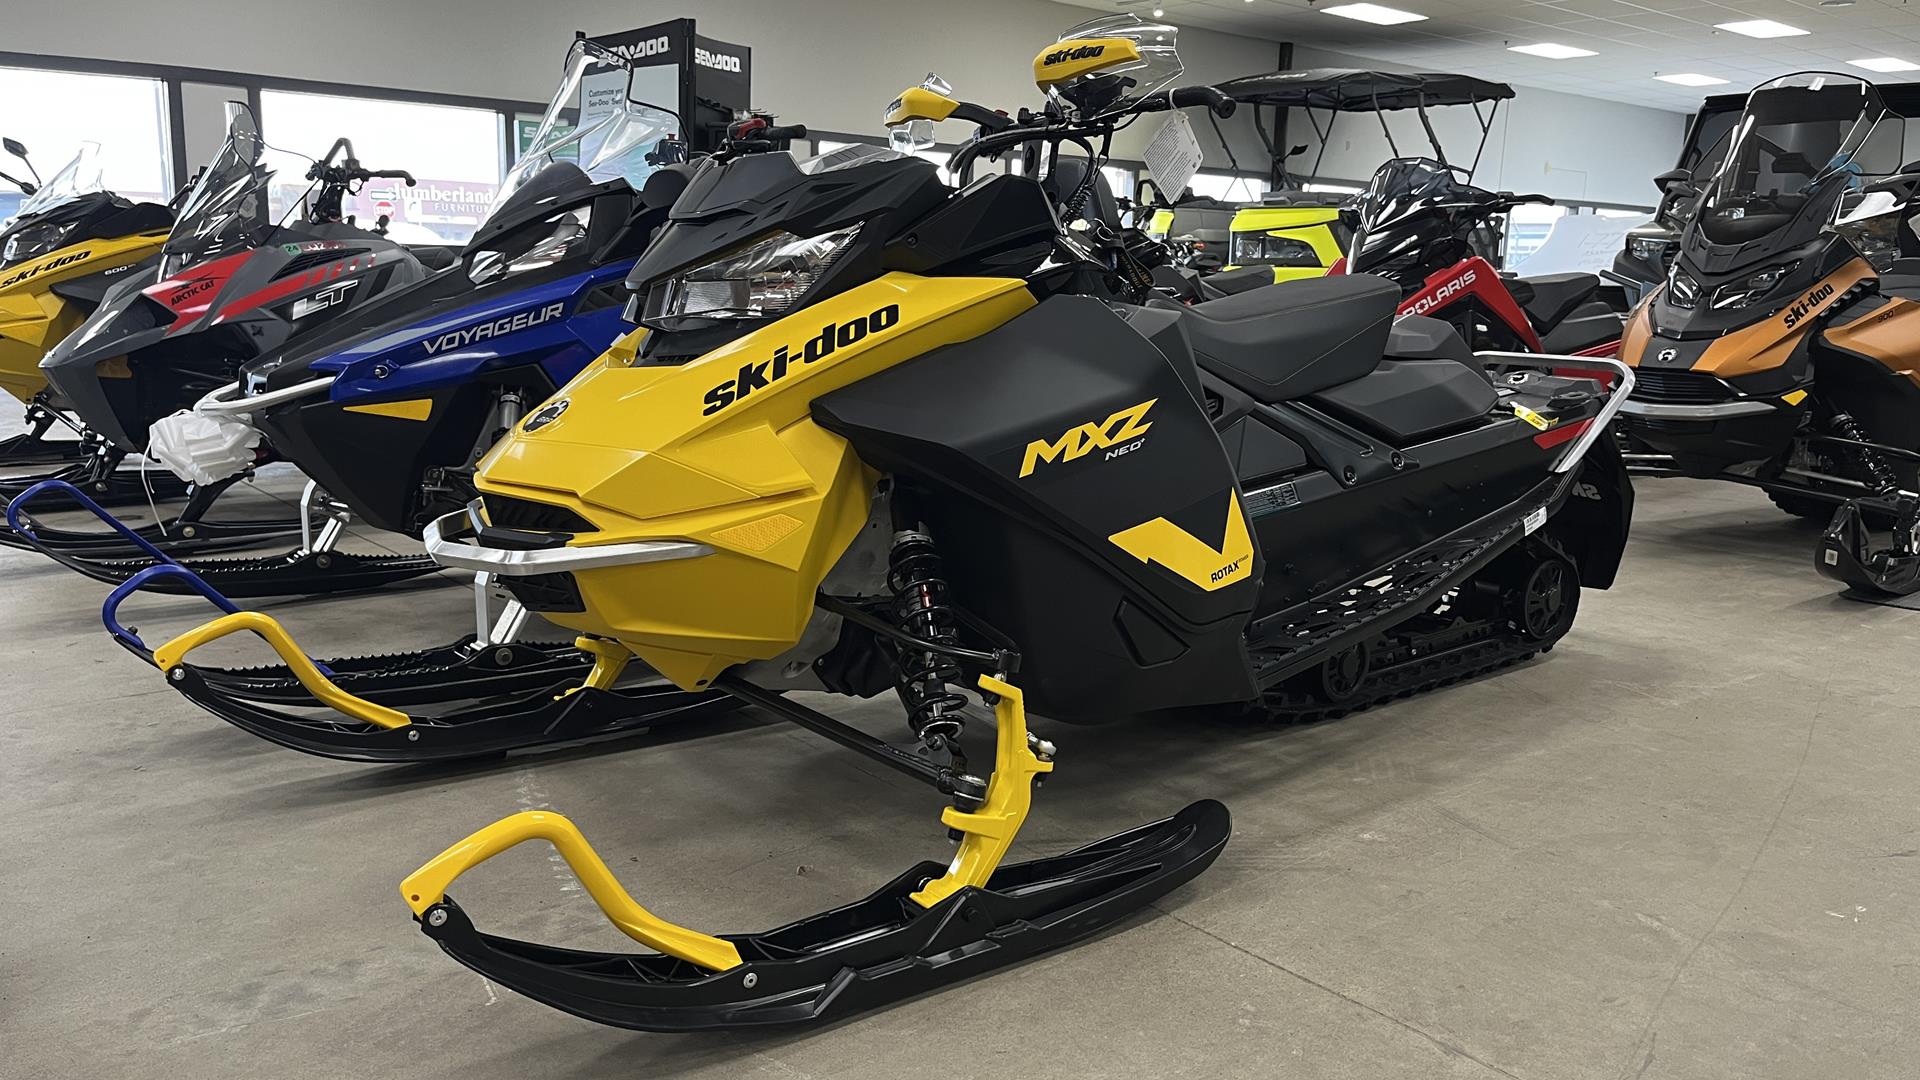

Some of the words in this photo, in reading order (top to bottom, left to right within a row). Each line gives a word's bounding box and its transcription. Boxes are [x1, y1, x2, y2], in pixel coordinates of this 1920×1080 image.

[104, 266, 128, 276] 600
[171, 286, 200, 306] ARCTIC
[200, 279, 215, 291] CAT
[292, 279, 358, 321] LT
[1783, 283, 1835, 329] ski-doo
[422, 302, 564, 354] VOYAGEUR
[703, 304, 900, 417] ski-doo
[1018, 397, 1160, 479] MXZ
[1210, 559, 1239, 583] ROTAX
